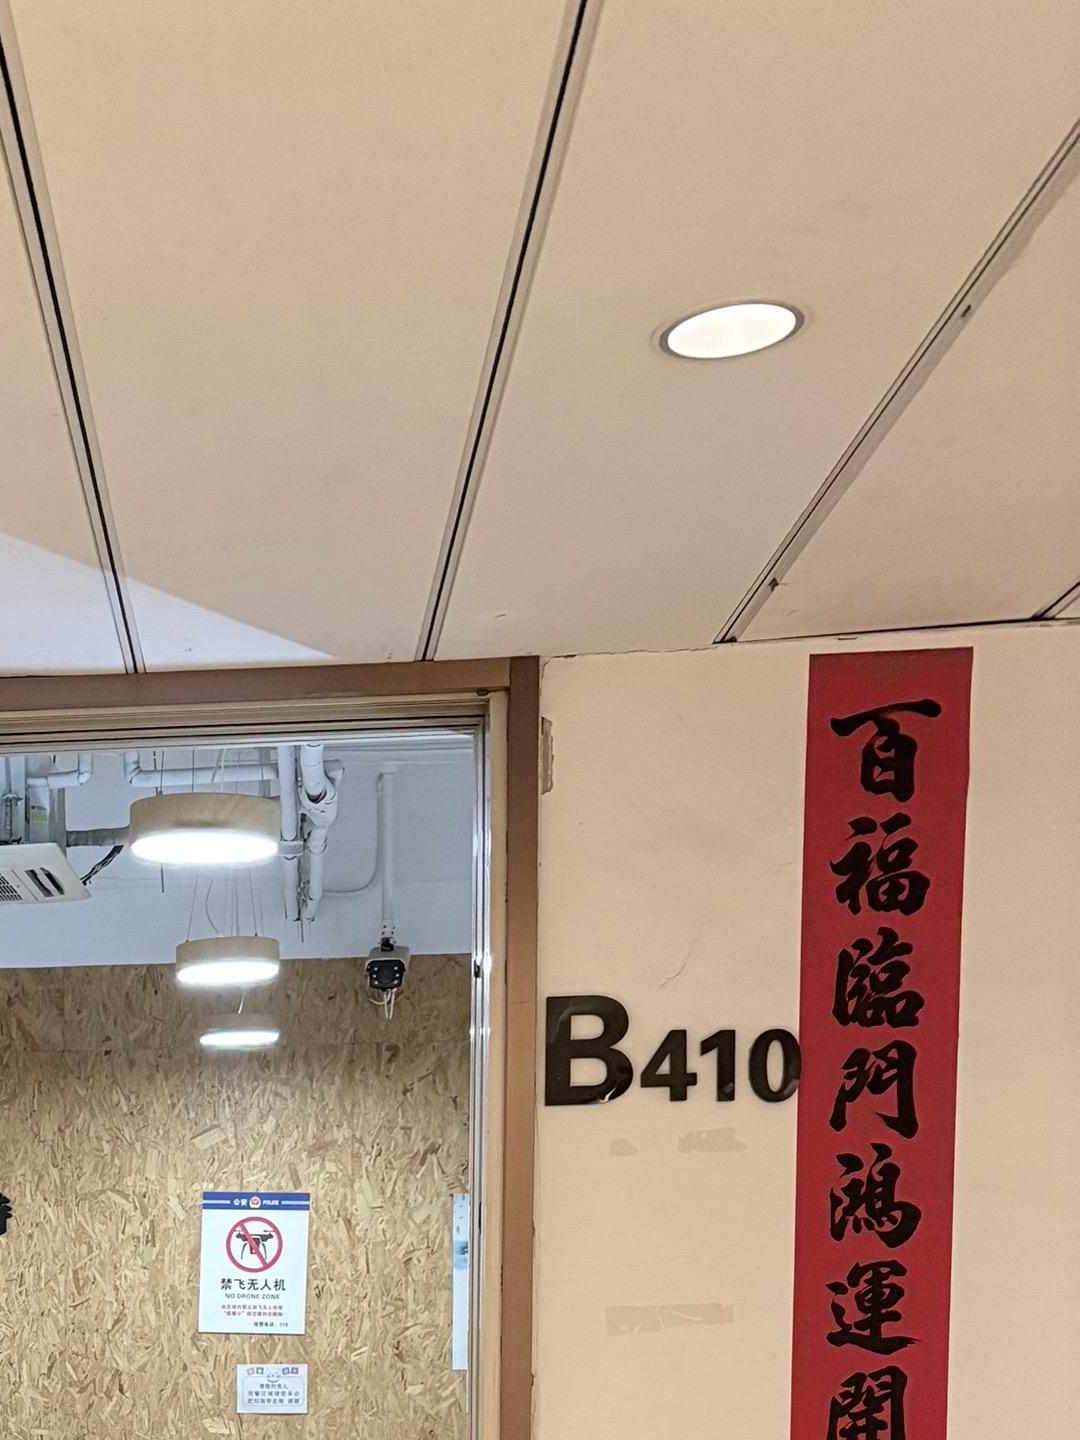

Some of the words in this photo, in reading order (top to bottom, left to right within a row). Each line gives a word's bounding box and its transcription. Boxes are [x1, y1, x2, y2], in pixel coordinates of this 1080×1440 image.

[543, 993, 801, 1108] B410
[220, 1278, 287, 1291] 禁飞无人机
